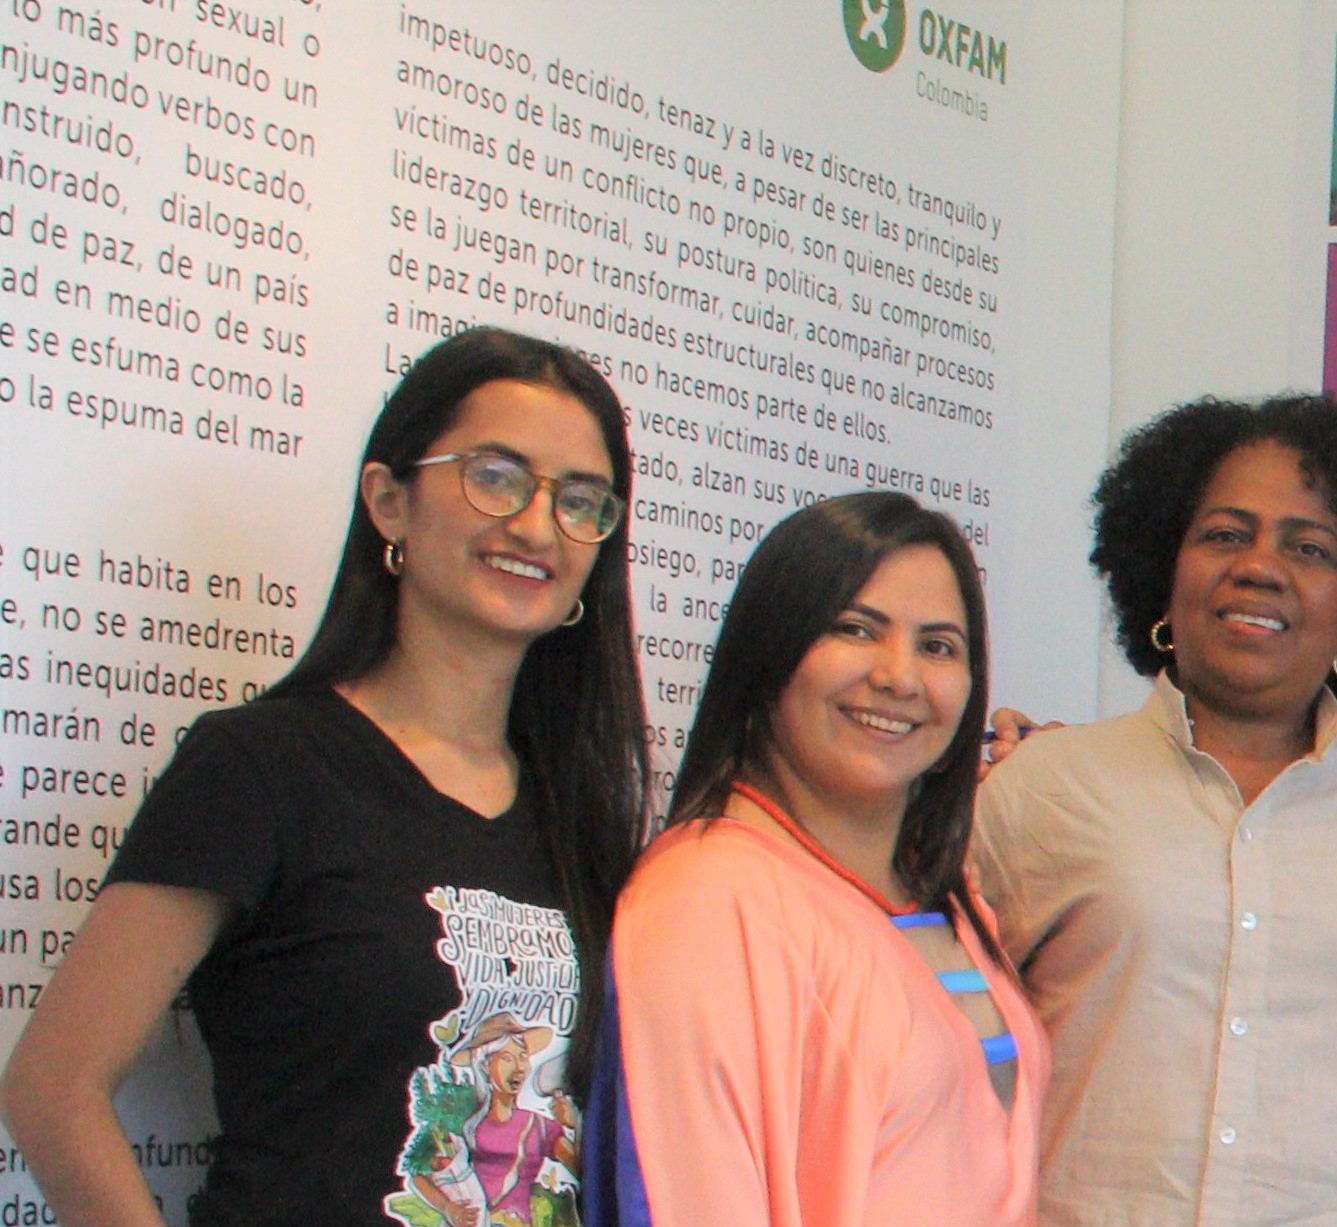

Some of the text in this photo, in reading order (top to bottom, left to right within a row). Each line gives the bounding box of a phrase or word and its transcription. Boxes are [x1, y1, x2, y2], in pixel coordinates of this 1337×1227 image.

[58, 7, 119, 47] más
[134, 30, 270, 93] profundo
[284, 77, 317, 108] un
[303, 34, 320, 57] o
[918, 8, 1007, 85] OXFAM
[158, 91, 255, 140] verbos
[264, 123, 314, 157] con
[400, 4, 1001, 241] impetuoso, decidido, tenaz y a la vez discreto, tranquilo y
[915, 70, 989, 122] Colombia
[186, 143, 311, 211] buscado,
[397, 60, 999, 274] amoroso de las mujeres que, a pesar de ser las principales
[0, 149, 309, 261] ñorado, dialogado,
[393, 149, 508, 212] liderazgo
[520, 189, 632, 250] territorial,
[644, 232, 667, 256] su
[677, 241, 755, 282] postura
[851, 293, 871, 316] su
[507, 138, 535, 171] de
[545, 155, 573, 182] un
[582, 168, 680, 215] conflicto
[689, 200, 715, 226] no
[723, 211, 794, 254] propio,
[802, 236, 836, 264] son
[844, 249, 915, 288] quienes
[922, 269, 973, 305] desde
[979, 291, 997, 313] su
[30, 212, 68, 250] de
[82, 232, 142, 272] paz,
[158, 244, 192, 280] de
[207, 262, 240, 291] un
[55, 280, 91, 310] en
[108, 291, 200, 333] medio
[215, 310, 249, 345] de
[262, 327, 306, 357] sus
[391, 205, 994, 390] se la juegan por transformar, cuidar, acompañar procesos
[26, 328, 59, 357] se
[71, 336, 179, 382] esfuma
[191, 363, 272, 400] como
[282, 374, 304, 408] la
[388, 248, 992, 429] de paz de profundidades estructurales que no alcanzamos
[29, 374, 53, 411] la
[66, 391, 183, 435] espuma
[195, 409, 238, 446] del
[250, 427, 303, 457] mar
[621, 360, 648, 385] no
[656, 362, 749, 410] hacemos
[756, 394, 807, 424] parte
[814, 403, 836, 431] de
[640, 410, 699, 442] veces
[795, 441, 818, 469] de
[825, 453, 859, 478] una
[866, 462, 924, 492] guerra
[930, 477, 962, 502] que
[968, 479, 990, 507] las
[692, 462, 745, 496] alzan
[753, 479, 785, 504] sus
[635, 500, 723, 535] caminos
[22, 546, 297, 609] que habita en los
[650, 584, 667, 613] la
[42, 604, 81, 632] no
[95, 611, 127, 638] se
[139, 616, 294, 658] amedrenta
[46, 650, 227, 702] inequidades
[120, 713, 156, 747] de
[21, 766, 126, 800] parece
[0, 815, 80, 848] ande
